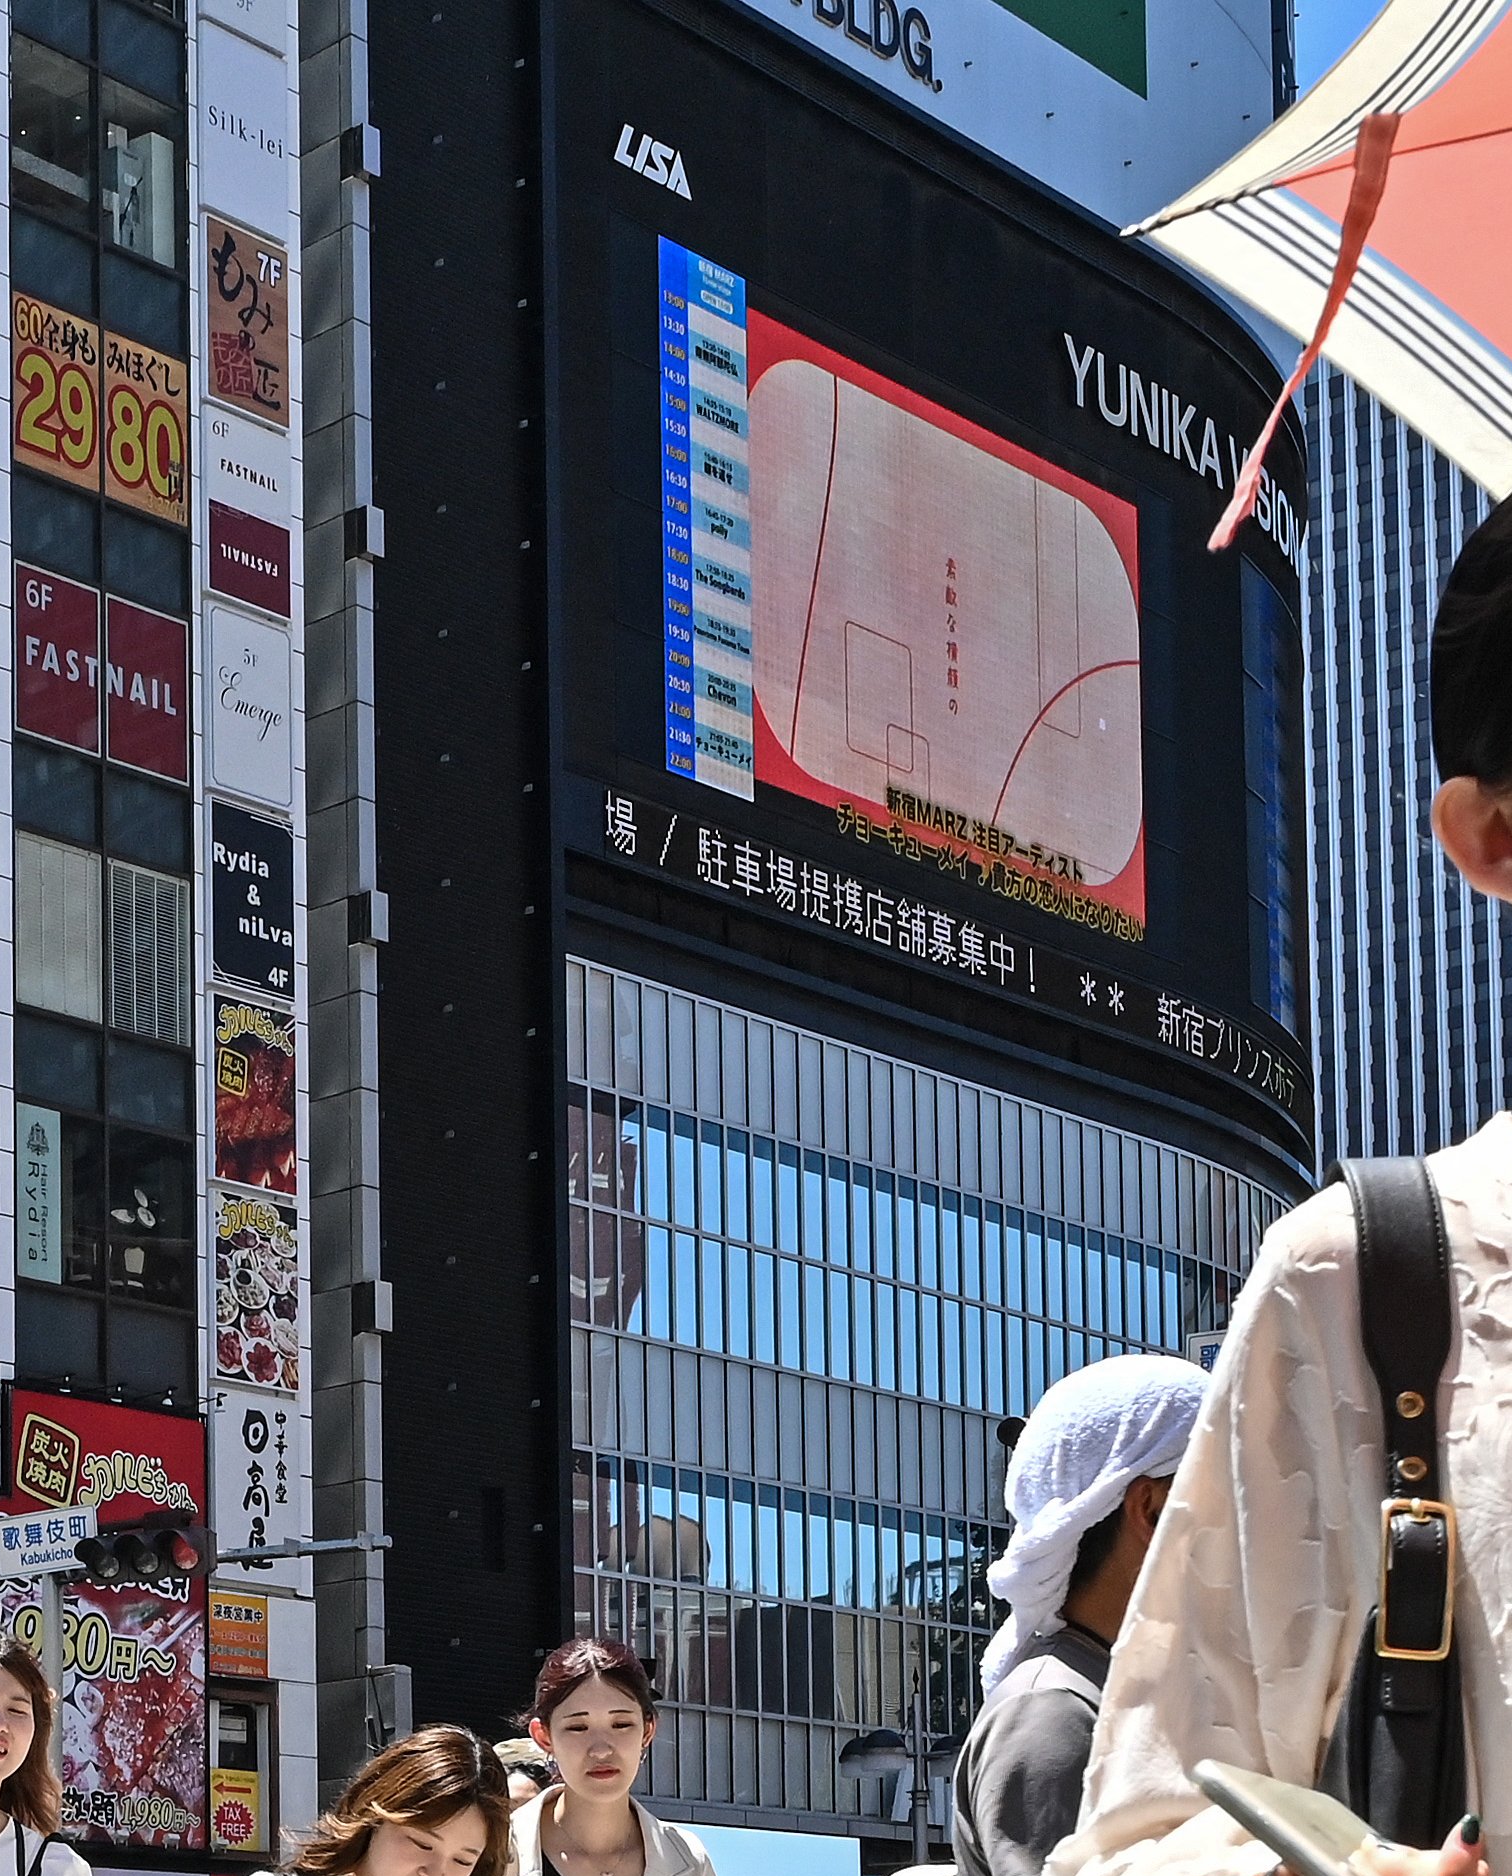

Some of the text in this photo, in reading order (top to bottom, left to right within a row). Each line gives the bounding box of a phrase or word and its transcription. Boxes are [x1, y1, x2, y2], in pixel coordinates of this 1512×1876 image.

[207, 105, 285, 159] Silk-lei
[613, 124, 693, 201] LISA
[257, 252, 282, 287] 7F
[212, 418, 230, 439] 6F
[1063, 332, 1302, 578] YUNIKA VSION
[220, 458, 278, 493] FASTNAIL
[666, 520, 689, 540] 17:30
[220, 543, 279, 577] FASTNAIL
[24, 579, 53, 613] 6F
[242, 647, 259, 669] 5F
[24, 635, 178, 717] FASTNAIL
[218, 665, 284, 744] Emerge
[886, 785, 1083, 884] 新宿MARZ 注目アーティスト
[213, 840, 270, 879] Rydia
[246, 883, 262, 907] &
[238, 915, 293, 948] niLva
[267, 966, 289, 989] 4F
[27, 1160, 40, 1263] Rydia
[29, 1427, 72, 1470] 炭火
[274, 1409, 288, 1507] 中華食堂
[26, 1457, 69, 1498] 焼肉
[2, 1515, 88, 1552] 歌舞伎町
[19, 1547, 74, 1567] Kabukicho
[220, 1822, 247, 1838] FREE
[223, 1807, 242, 1822] TAX
